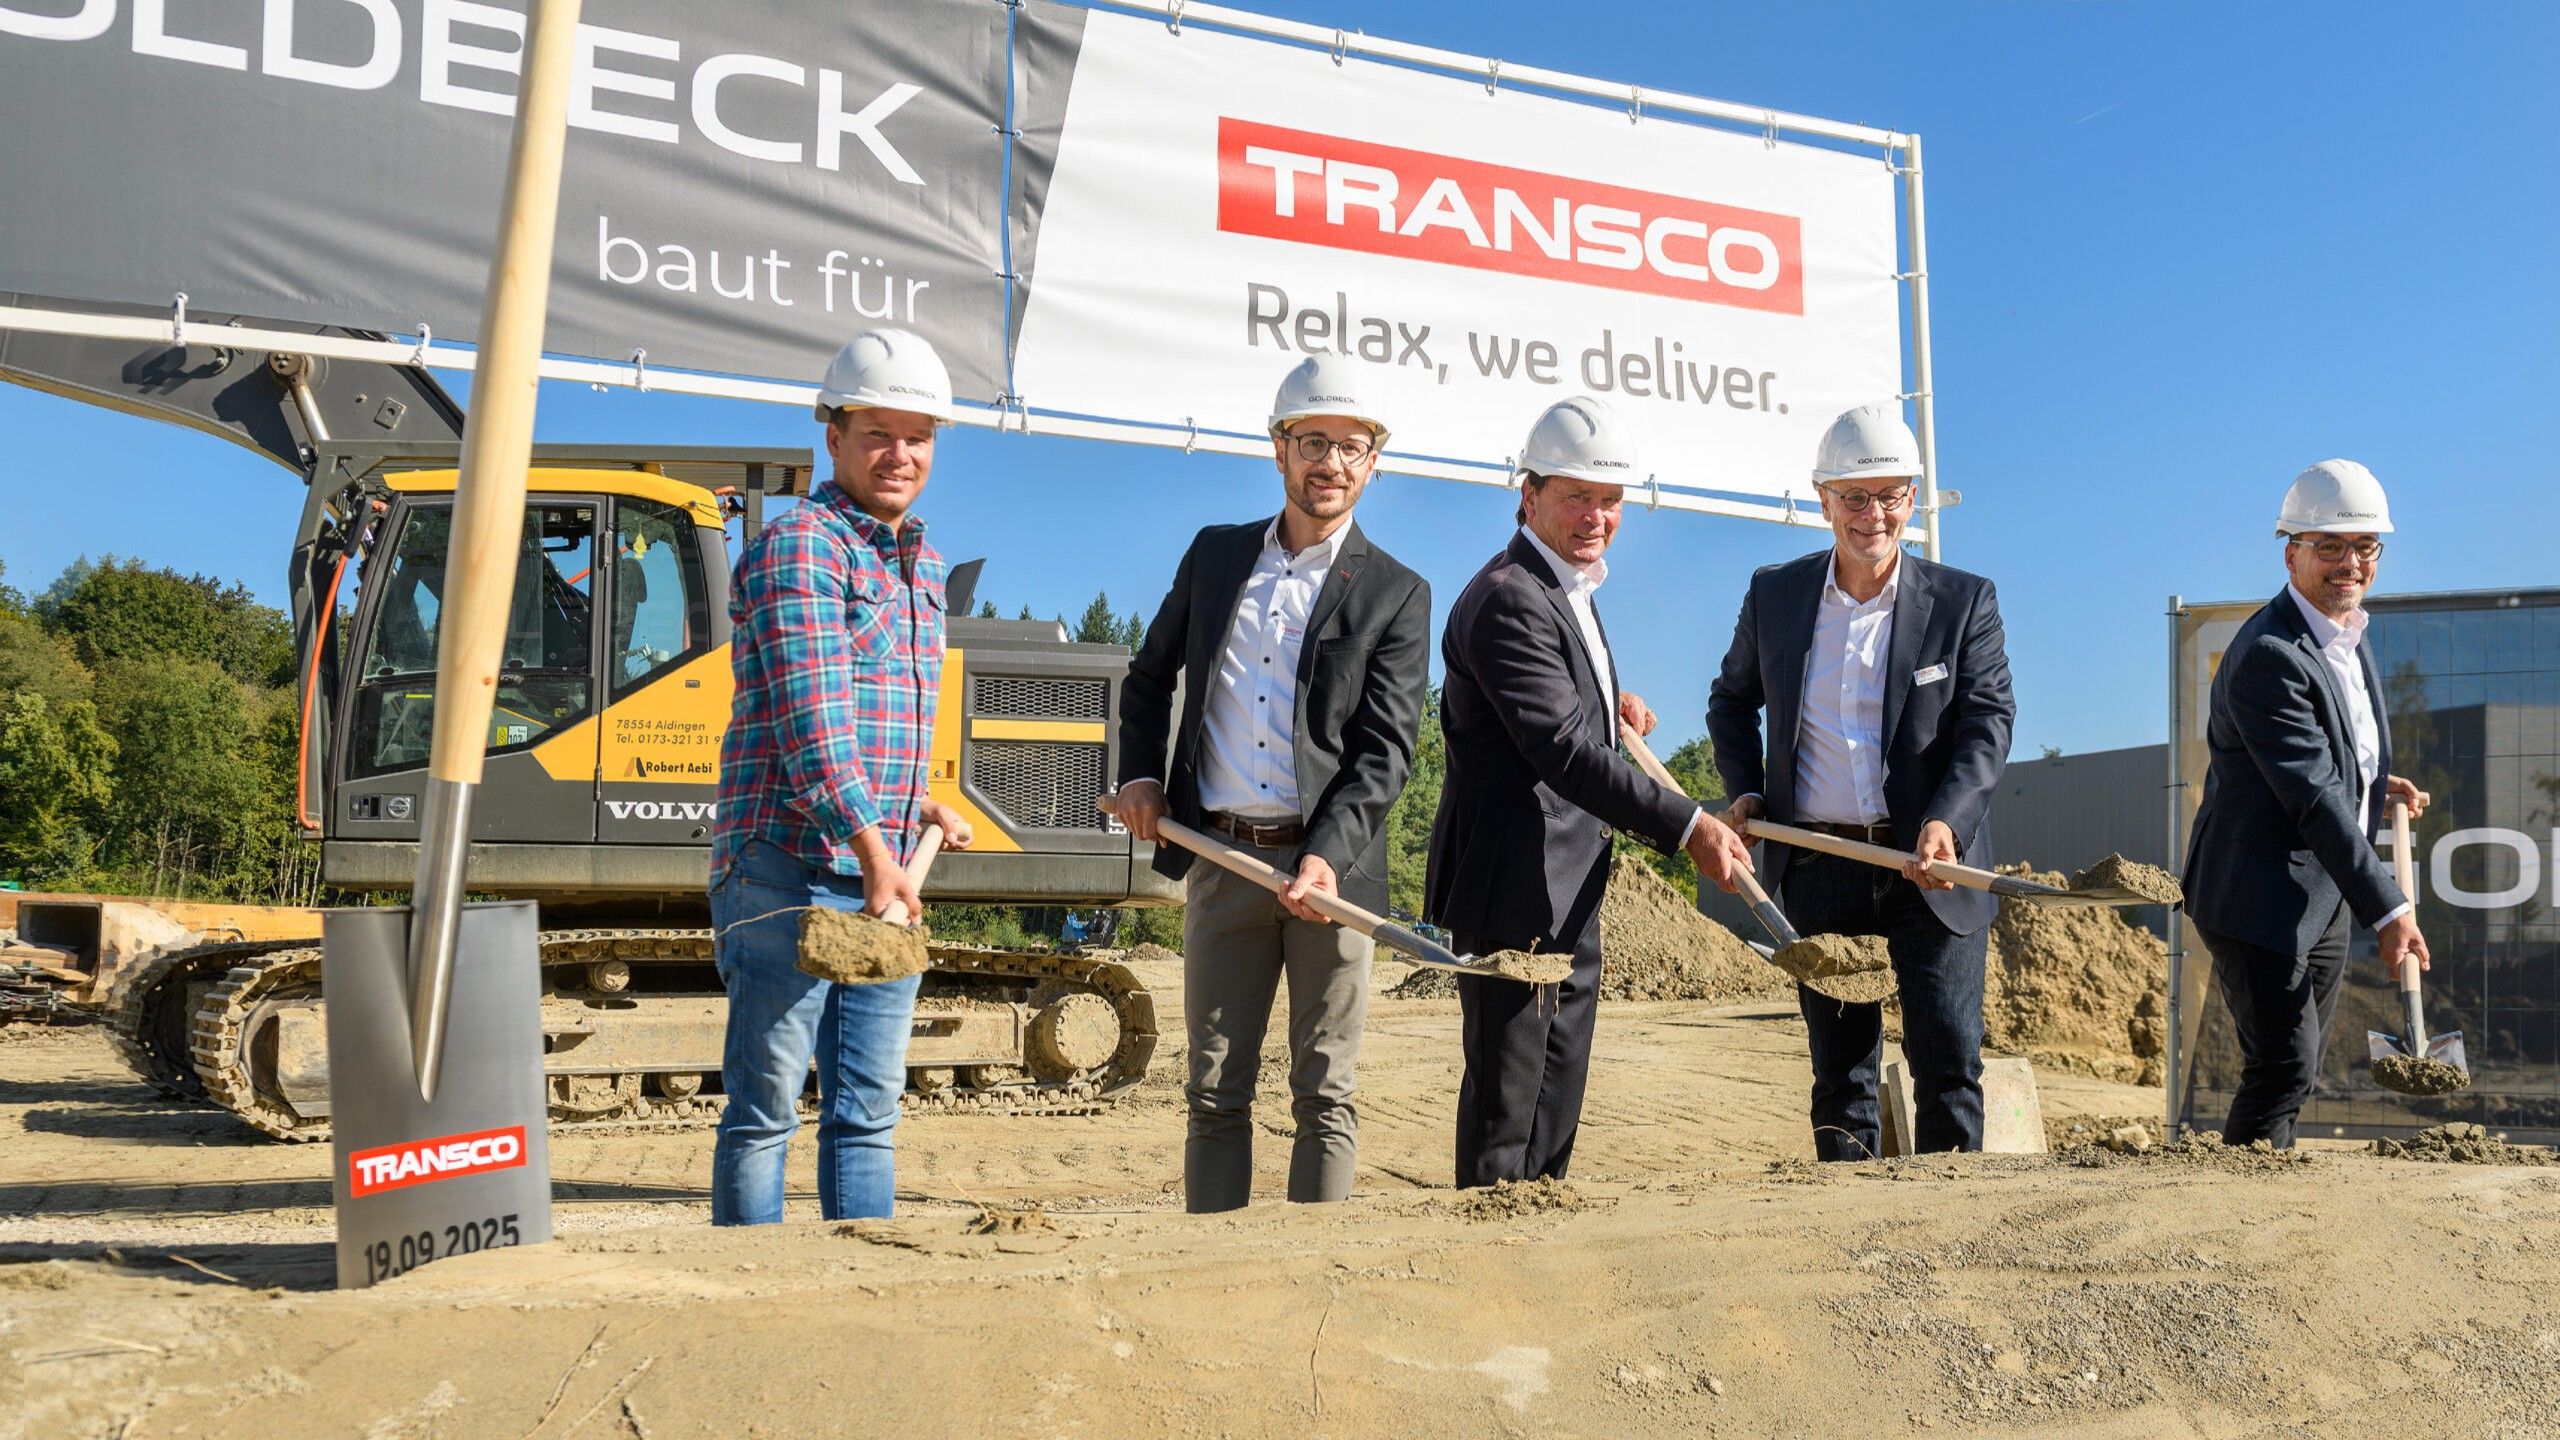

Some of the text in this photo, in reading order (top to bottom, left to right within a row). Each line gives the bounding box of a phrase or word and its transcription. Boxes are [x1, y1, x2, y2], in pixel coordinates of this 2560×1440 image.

[1246, 145, 1780, 290] TRANSCO
[599, 215, 930, 323] baut für
[1247, 282, 1789, 415] Relax, we deliver.
[1308, 395, 1356, 404] GOLDBECK
[1593, 460, 1631, 469] GOLDBECK
[616, 719, 706, 732] 78554 Aldingen
[616, 734, 725, 744] Tel. 0173-321 31 9
[646, 761, 713, 773] Robert Aebi
[356, 1135, 519, 1187] TRANSCO
[364, 1214, 520, 1285] 19.092025
